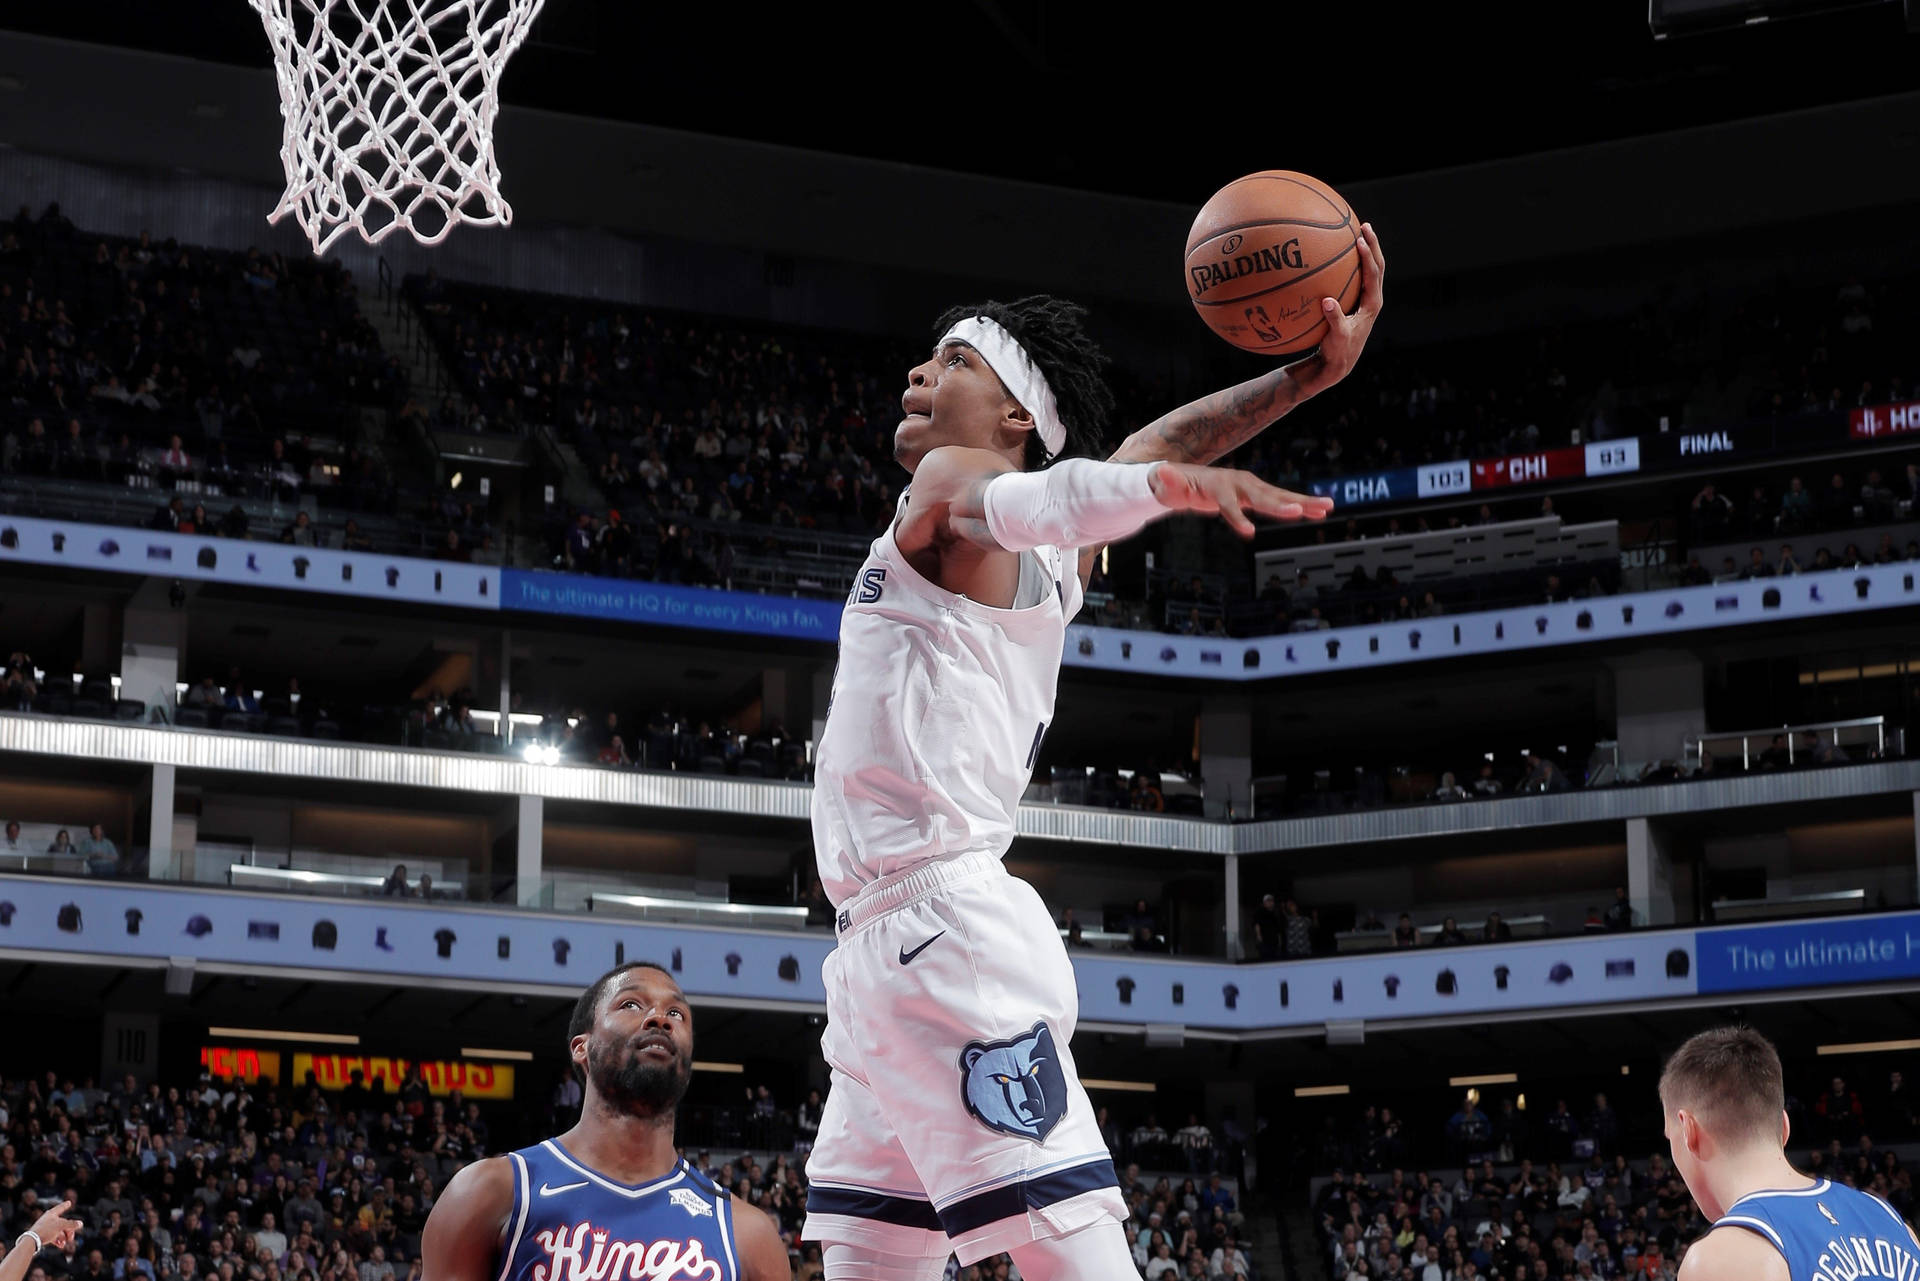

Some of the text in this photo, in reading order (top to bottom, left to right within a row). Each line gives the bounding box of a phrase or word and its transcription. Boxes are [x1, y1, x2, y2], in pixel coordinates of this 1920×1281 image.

[1191, 238, 1303, 296] SPALDING
[1680, 430, 1734, 456] FINAL
[1344, 476, 1391, 504] CHA
[1429, 470, 1463, 489] 103
[1509, 454, 1548, 483] CHI
[520, 580, 823, 629] The ultimate HQ for every Kings fan.
[1728, 944, 1775, 972] The
[1785, 937, 1895, 968] ultimate
[533, 1221, 722, 1281] Kings
